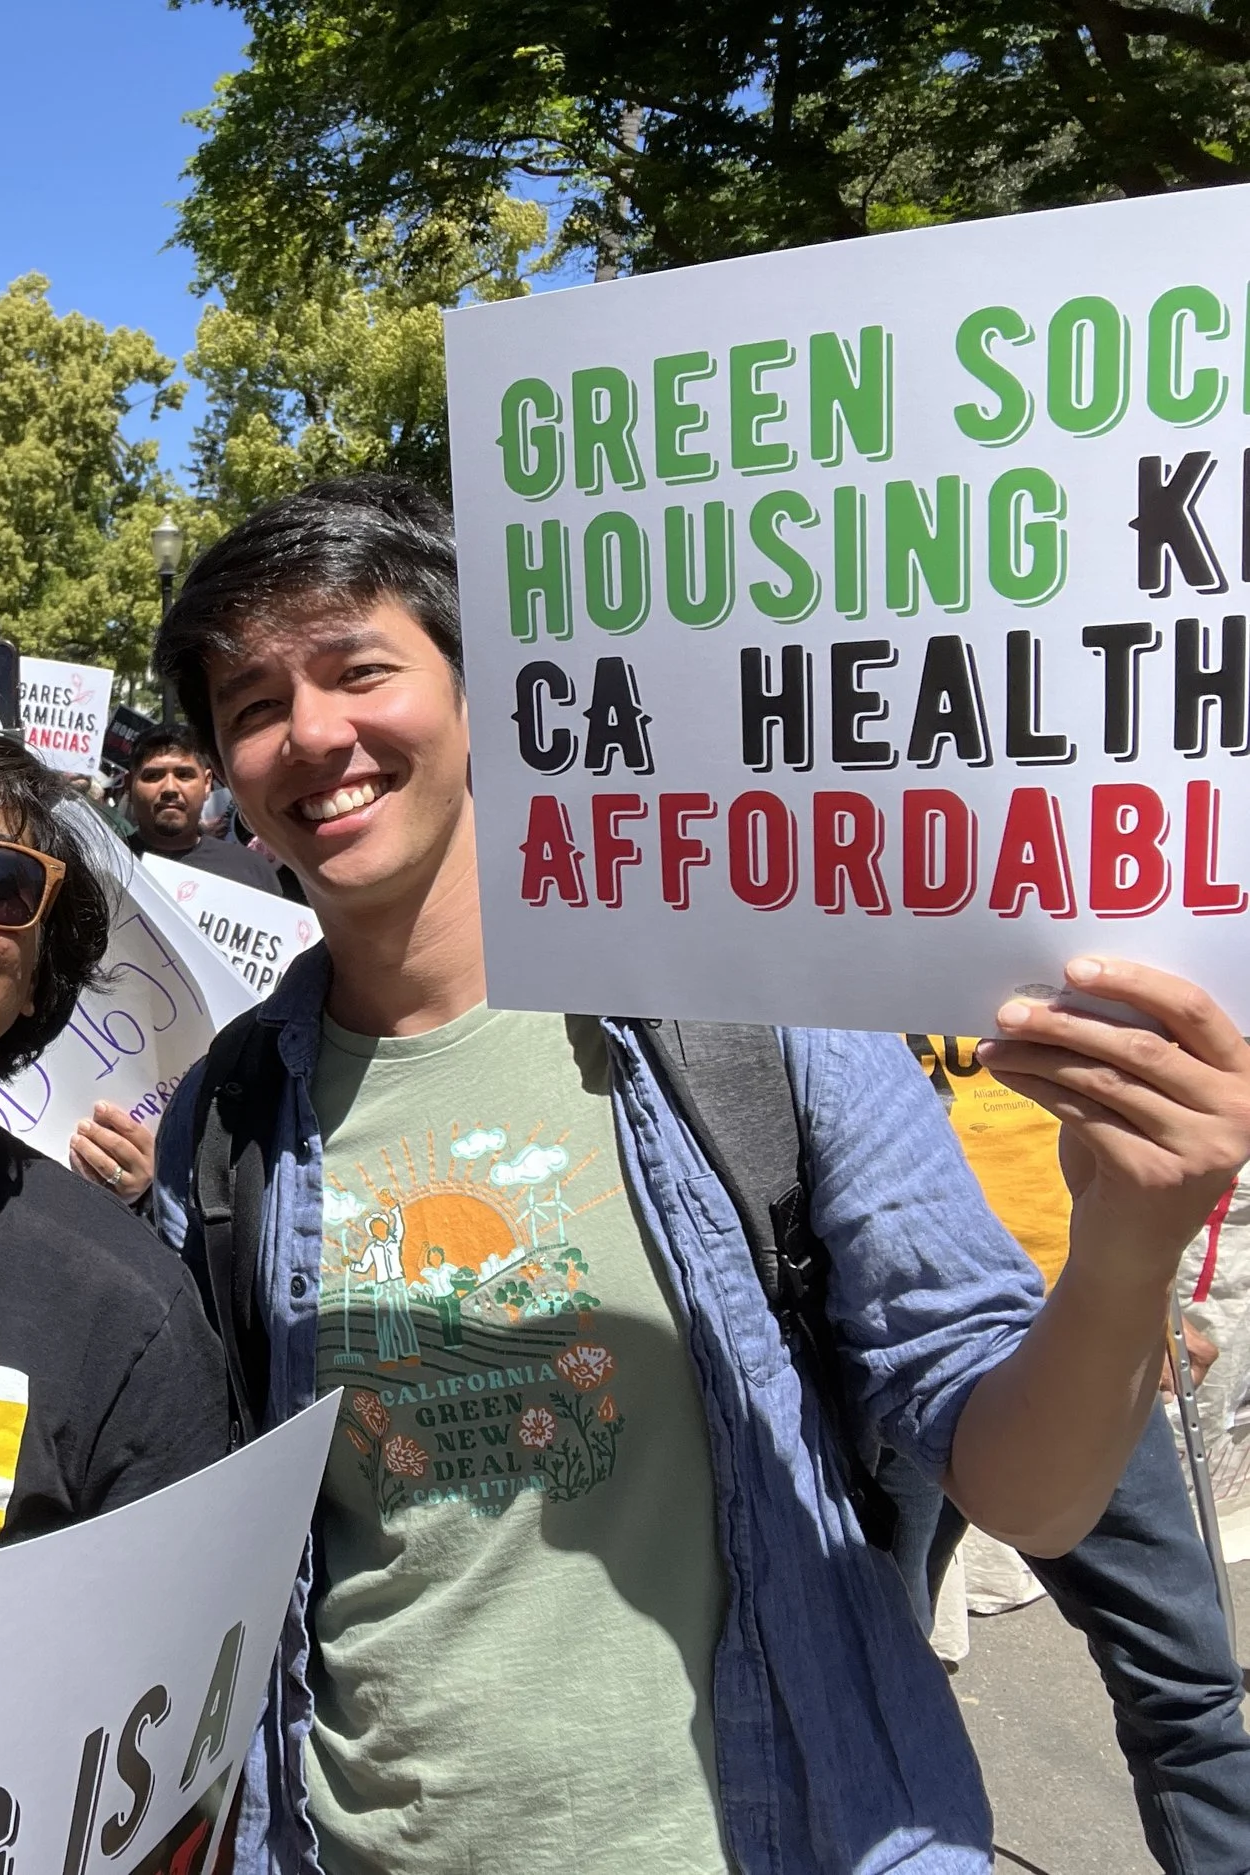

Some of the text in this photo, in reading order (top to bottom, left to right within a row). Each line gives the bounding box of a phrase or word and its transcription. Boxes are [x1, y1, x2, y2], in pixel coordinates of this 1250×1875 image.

[495, 282, 1250, 503] GREEN SOC
[505, 467, 1067, 645] HOUSING
[511, 613, 1250, 777] CA HEALTH
[26, 727, 91, 754] ANCIAS
[519, 778, 1249, 921] AFFORDABL
[198, 910, 283, 962] HOMES
[973, 1088, 1009, 1100] Alliance
[983, 1099, 1035, 1113] Community
[379, 1363, 557, 1407] CALIFORNIA
[415, 1391, 524, 1428] GREEN
[434, 1424, 511, 1452] NEW
[433, 1452, 522, 1481] DEAL
[62, 1684, 171, 1875] IS
[179, 1620, 246, 1793] A
